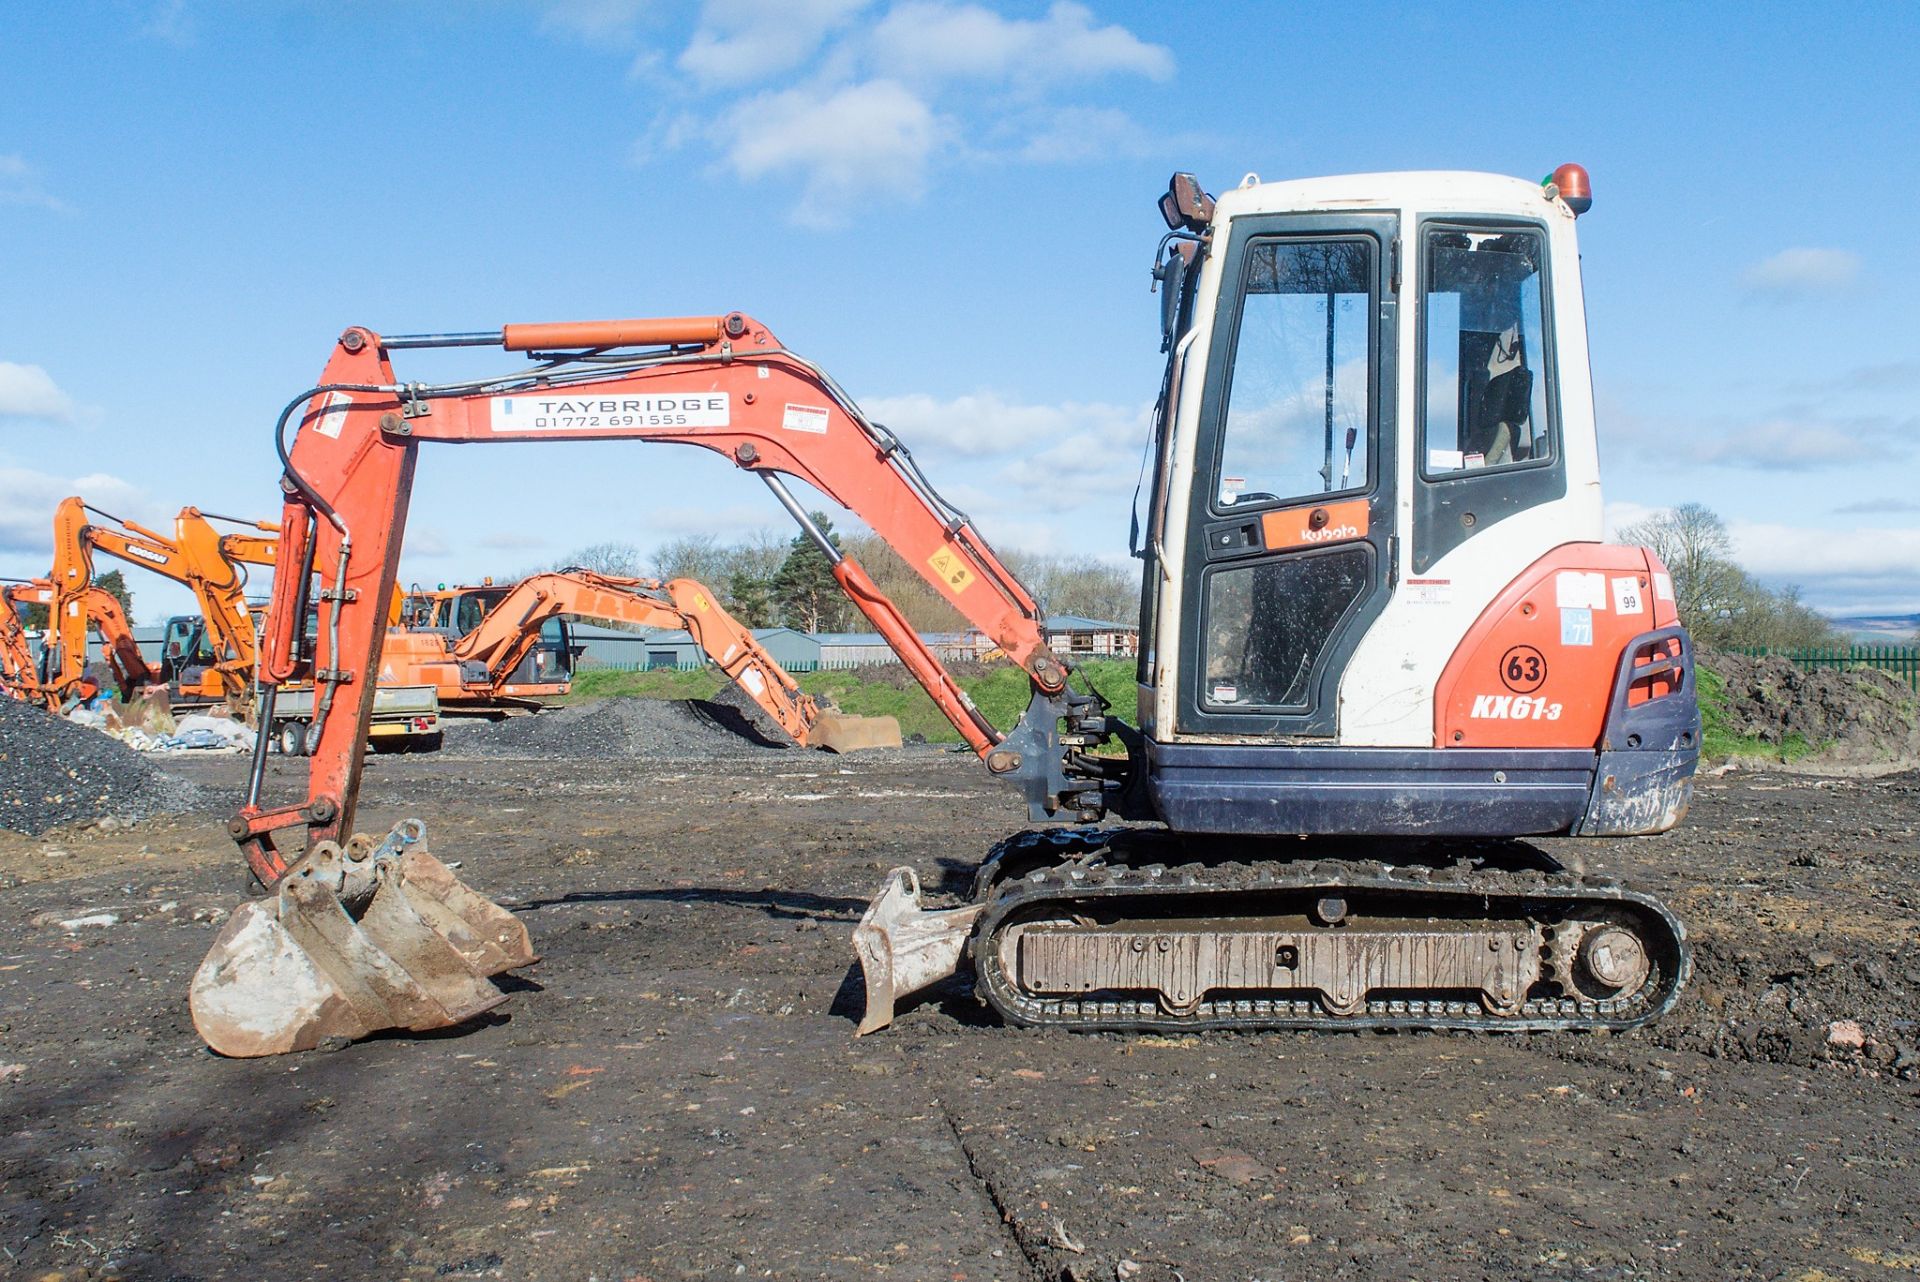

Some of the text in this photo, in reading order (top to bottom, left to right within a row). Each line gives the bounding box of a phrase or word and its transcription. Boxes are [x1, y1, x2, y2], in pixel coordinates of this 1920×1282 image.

[538, 398, 725, 414] TAYBRIDGE
[535, 413, 688, 429] 01772 691555
[1301, 523, 1359, 543] Kubota
[1622, 595, 1637, 609] 99
[1572, 623, 1590, 643] 77
[1506, 655, 1541, 683] 63
[1470, 694, 1564, 721] KX61-3
